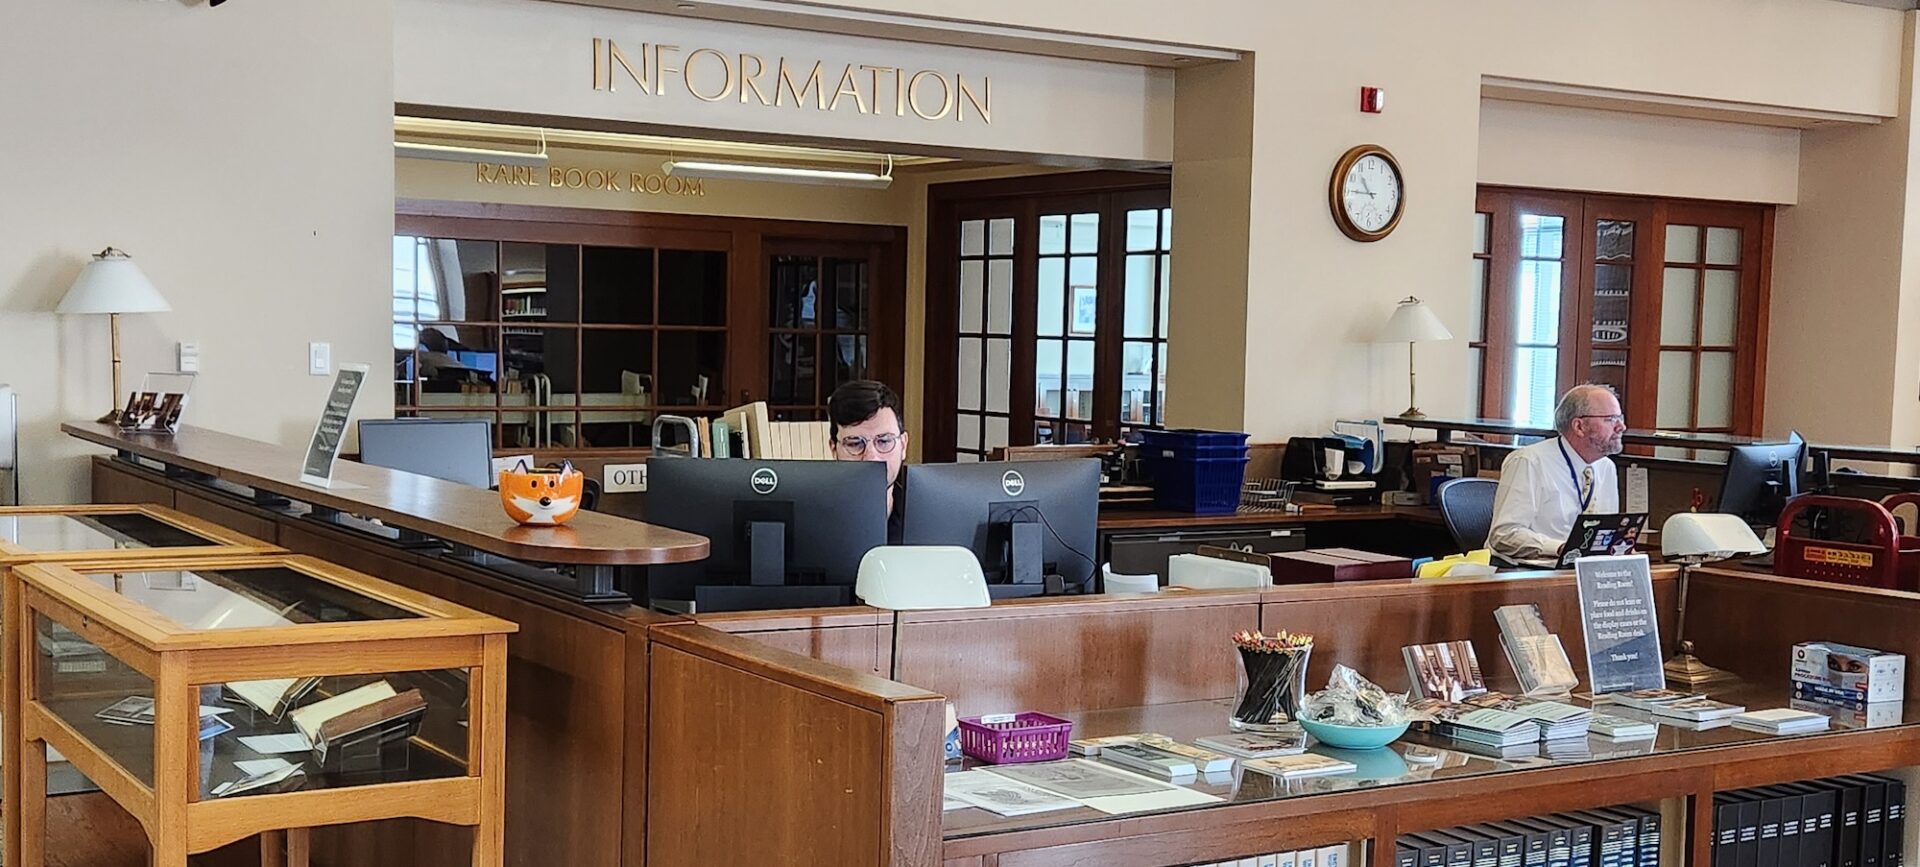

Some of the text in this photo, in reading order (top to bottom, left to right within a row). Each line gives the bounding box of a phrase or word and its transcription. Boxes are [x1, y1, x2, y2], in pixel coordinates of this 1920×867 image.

[592, 37, 992, 124] INFORMATION
[1368, 160, 1375, 170] 12
[549, 167, 621, 192] BOOK
[630, 172, 705, 197] ROOM
[754, 477, 774, 485] DELL
[1594, 570, 1617, 578] Welcome
[1597, 581, 1617, 589] Reading
[1593, 600, 1609, 608] Please
[1590, 611, 1603, 620] place
[1603, 609, 1615, 618] food
[1615, 609, 1624, 617] and
[1625, 608, 1641, 616] drinks
[1593, 621, 1601, 629] the
[1602, 620, 1619, 629] display
[1597, 632, 1618, 640] Reading
[1610, 651, 1639, 663] Thank you!
